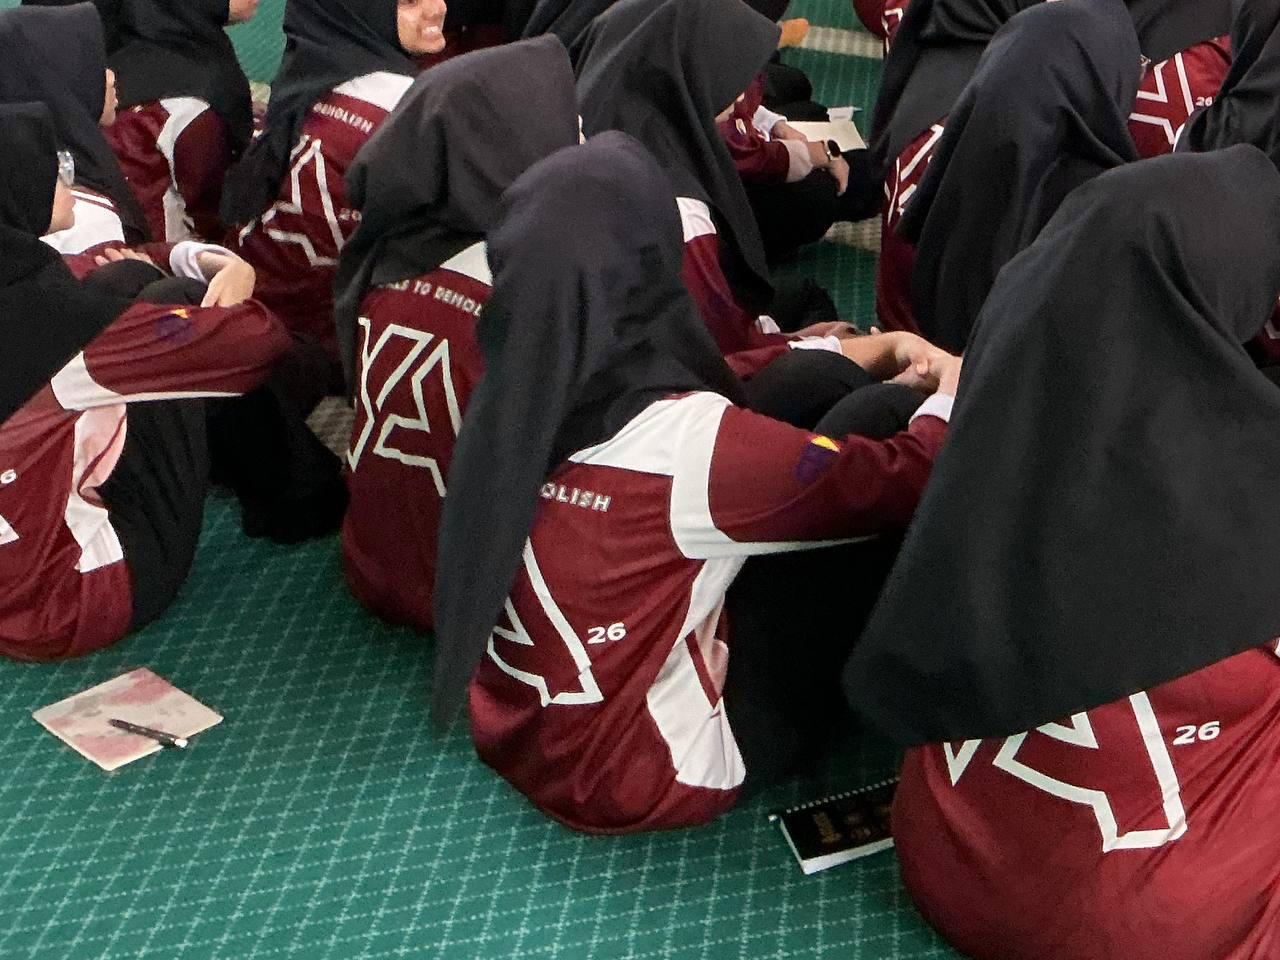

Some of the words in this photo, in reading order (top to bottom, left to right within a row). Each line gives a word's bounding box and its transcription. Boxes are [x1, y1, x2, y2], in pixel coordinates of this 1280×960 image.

[1195, 95, 1213, 108] 26
[433, 285, 483, 317] DEMOL
[540, 482, 612, 513] OLISH
[586, 622, 627, 645] 26
[1172, 720, 1221, 746] 26
